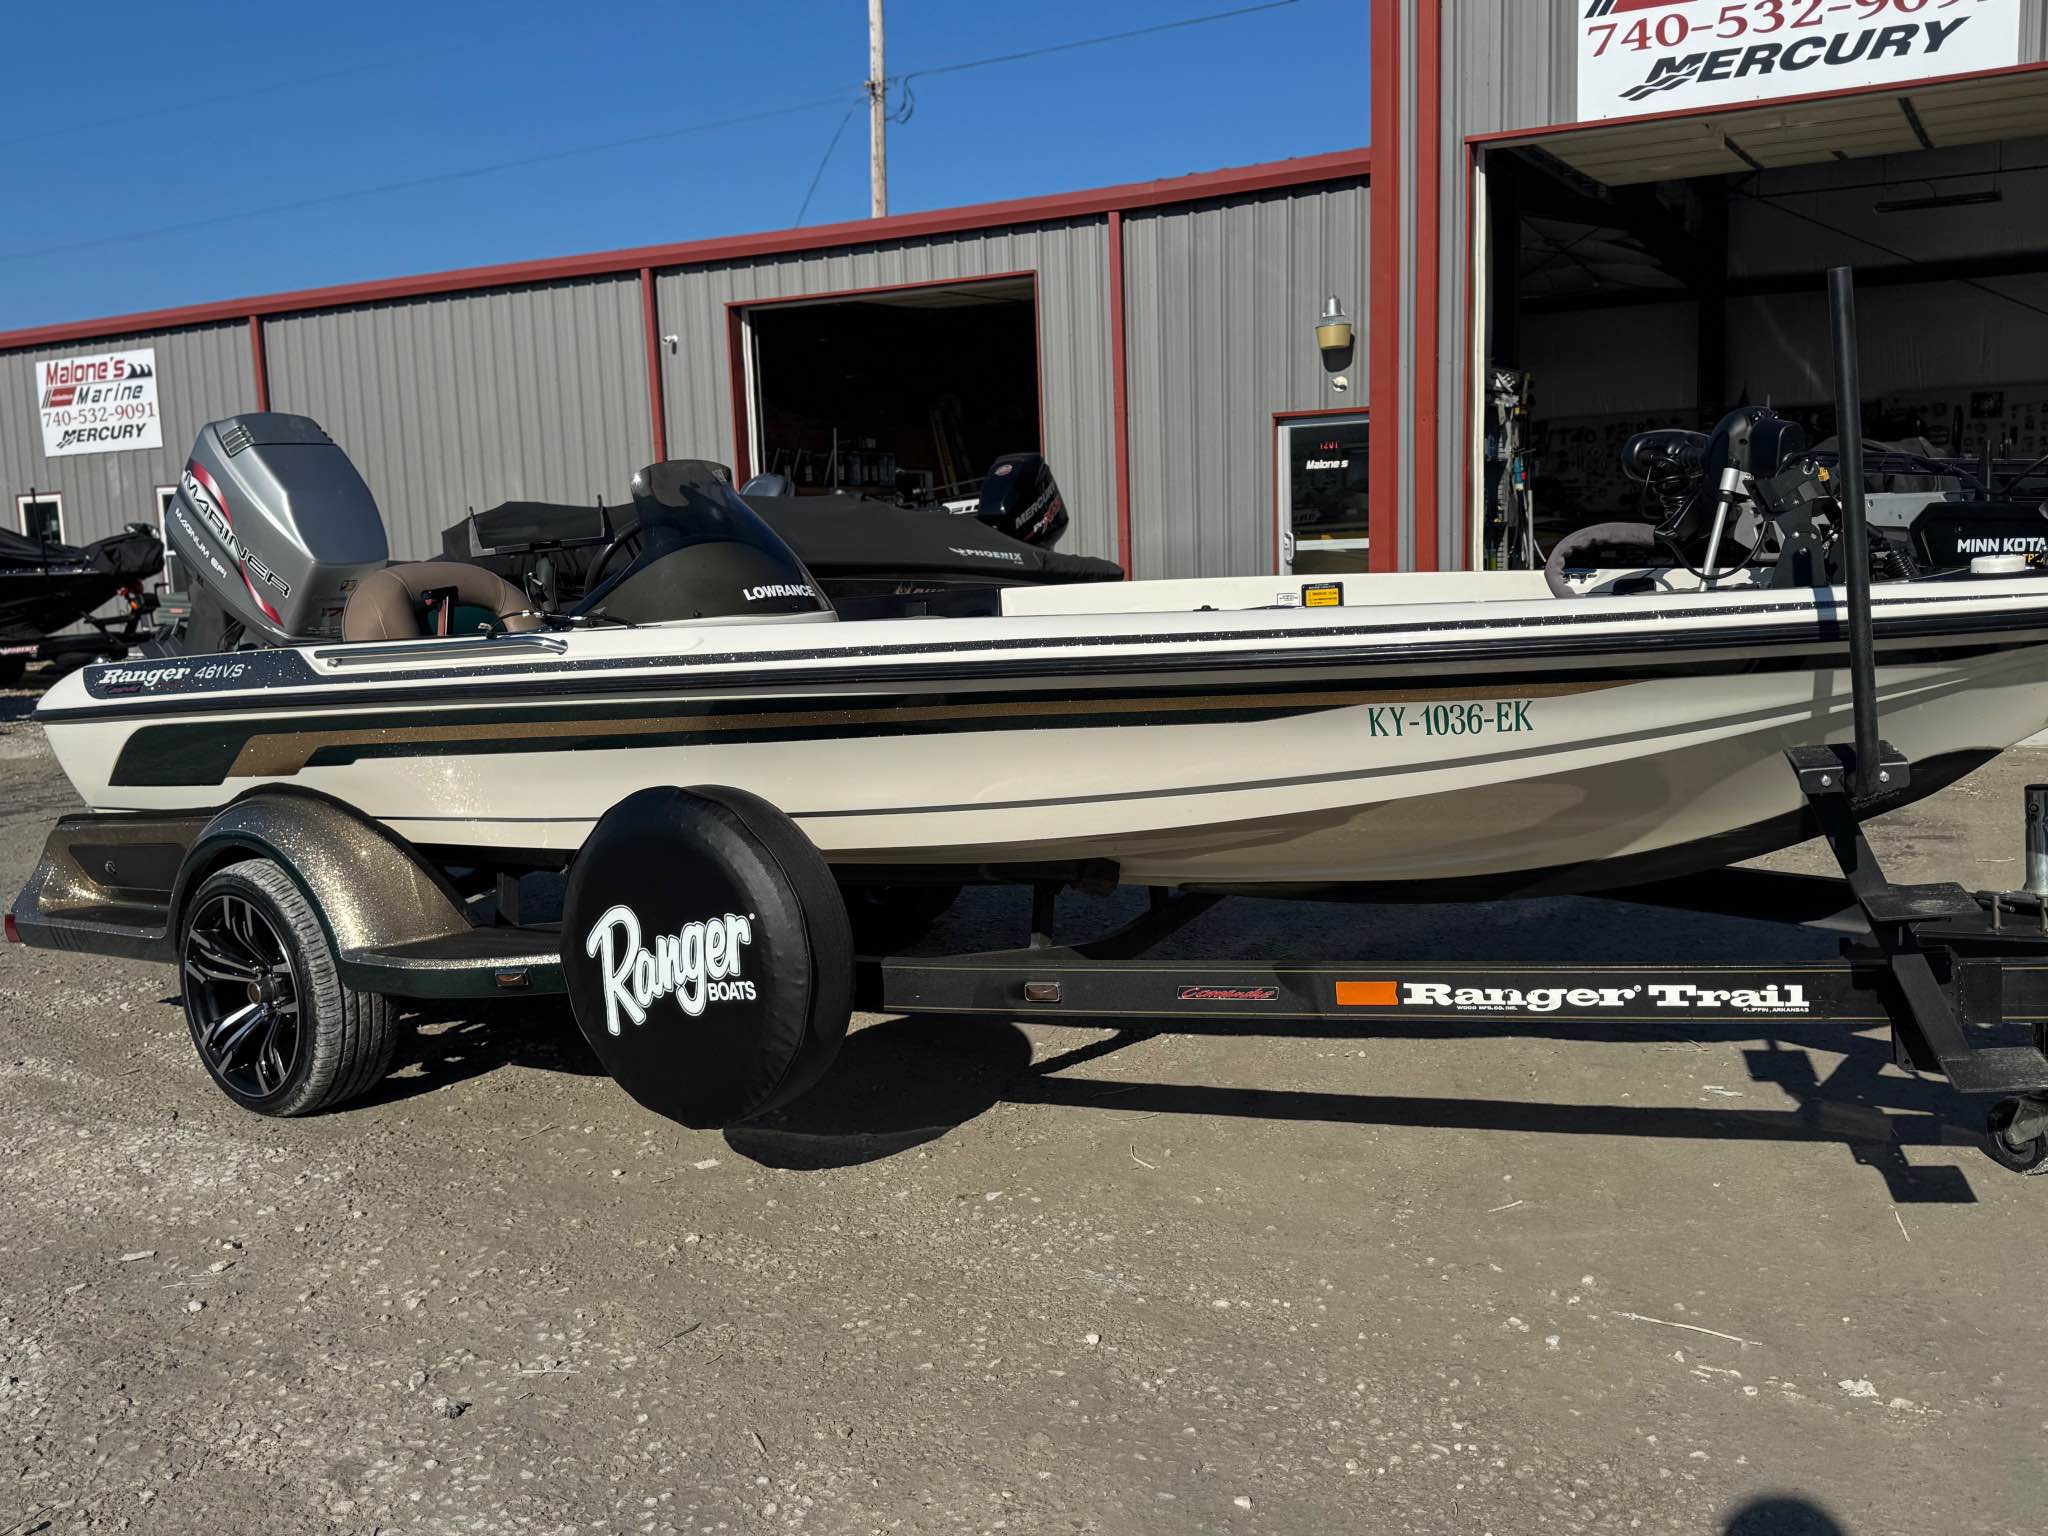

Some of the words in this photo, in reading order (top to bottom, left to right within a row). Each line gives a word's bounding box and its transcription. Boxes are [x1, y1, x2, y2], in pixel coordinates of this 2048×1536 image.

[1587, 0, 1992, 57] 740-532-9
[1618, 16, 1971, 101] MERCURY
[46, 356, 125, 386] Malone's
[76, 383, 143, 405] Marine
[43, 402, 156, 428] 740-532-9091
[56, 423, 146, 448] MERCURY
[1306, 460, 1349, 470] Malones
[175, 507, 210, 558] MAGNUM
[211, 557, 227, 579] EFI
[182, 470, 292, 598] MARINER
[1957, 538, 1999, 553] MINN
[2003, 537, 2046, 553] KOTA
[742, 584, 816, 601] LOWRANCE
[99, 666, 191, 687] Ranger
[194, 663, 245, 679] 461VS
[1368, 701, 1534, 737] KY-1036-EK
[587, 904, 751, 1036] Ranger
[708, 980, 757, 1001] BOATS
[1403, 982, 1637, 1012] Ranger
[1648, 984, 1810, 1007] Trail
